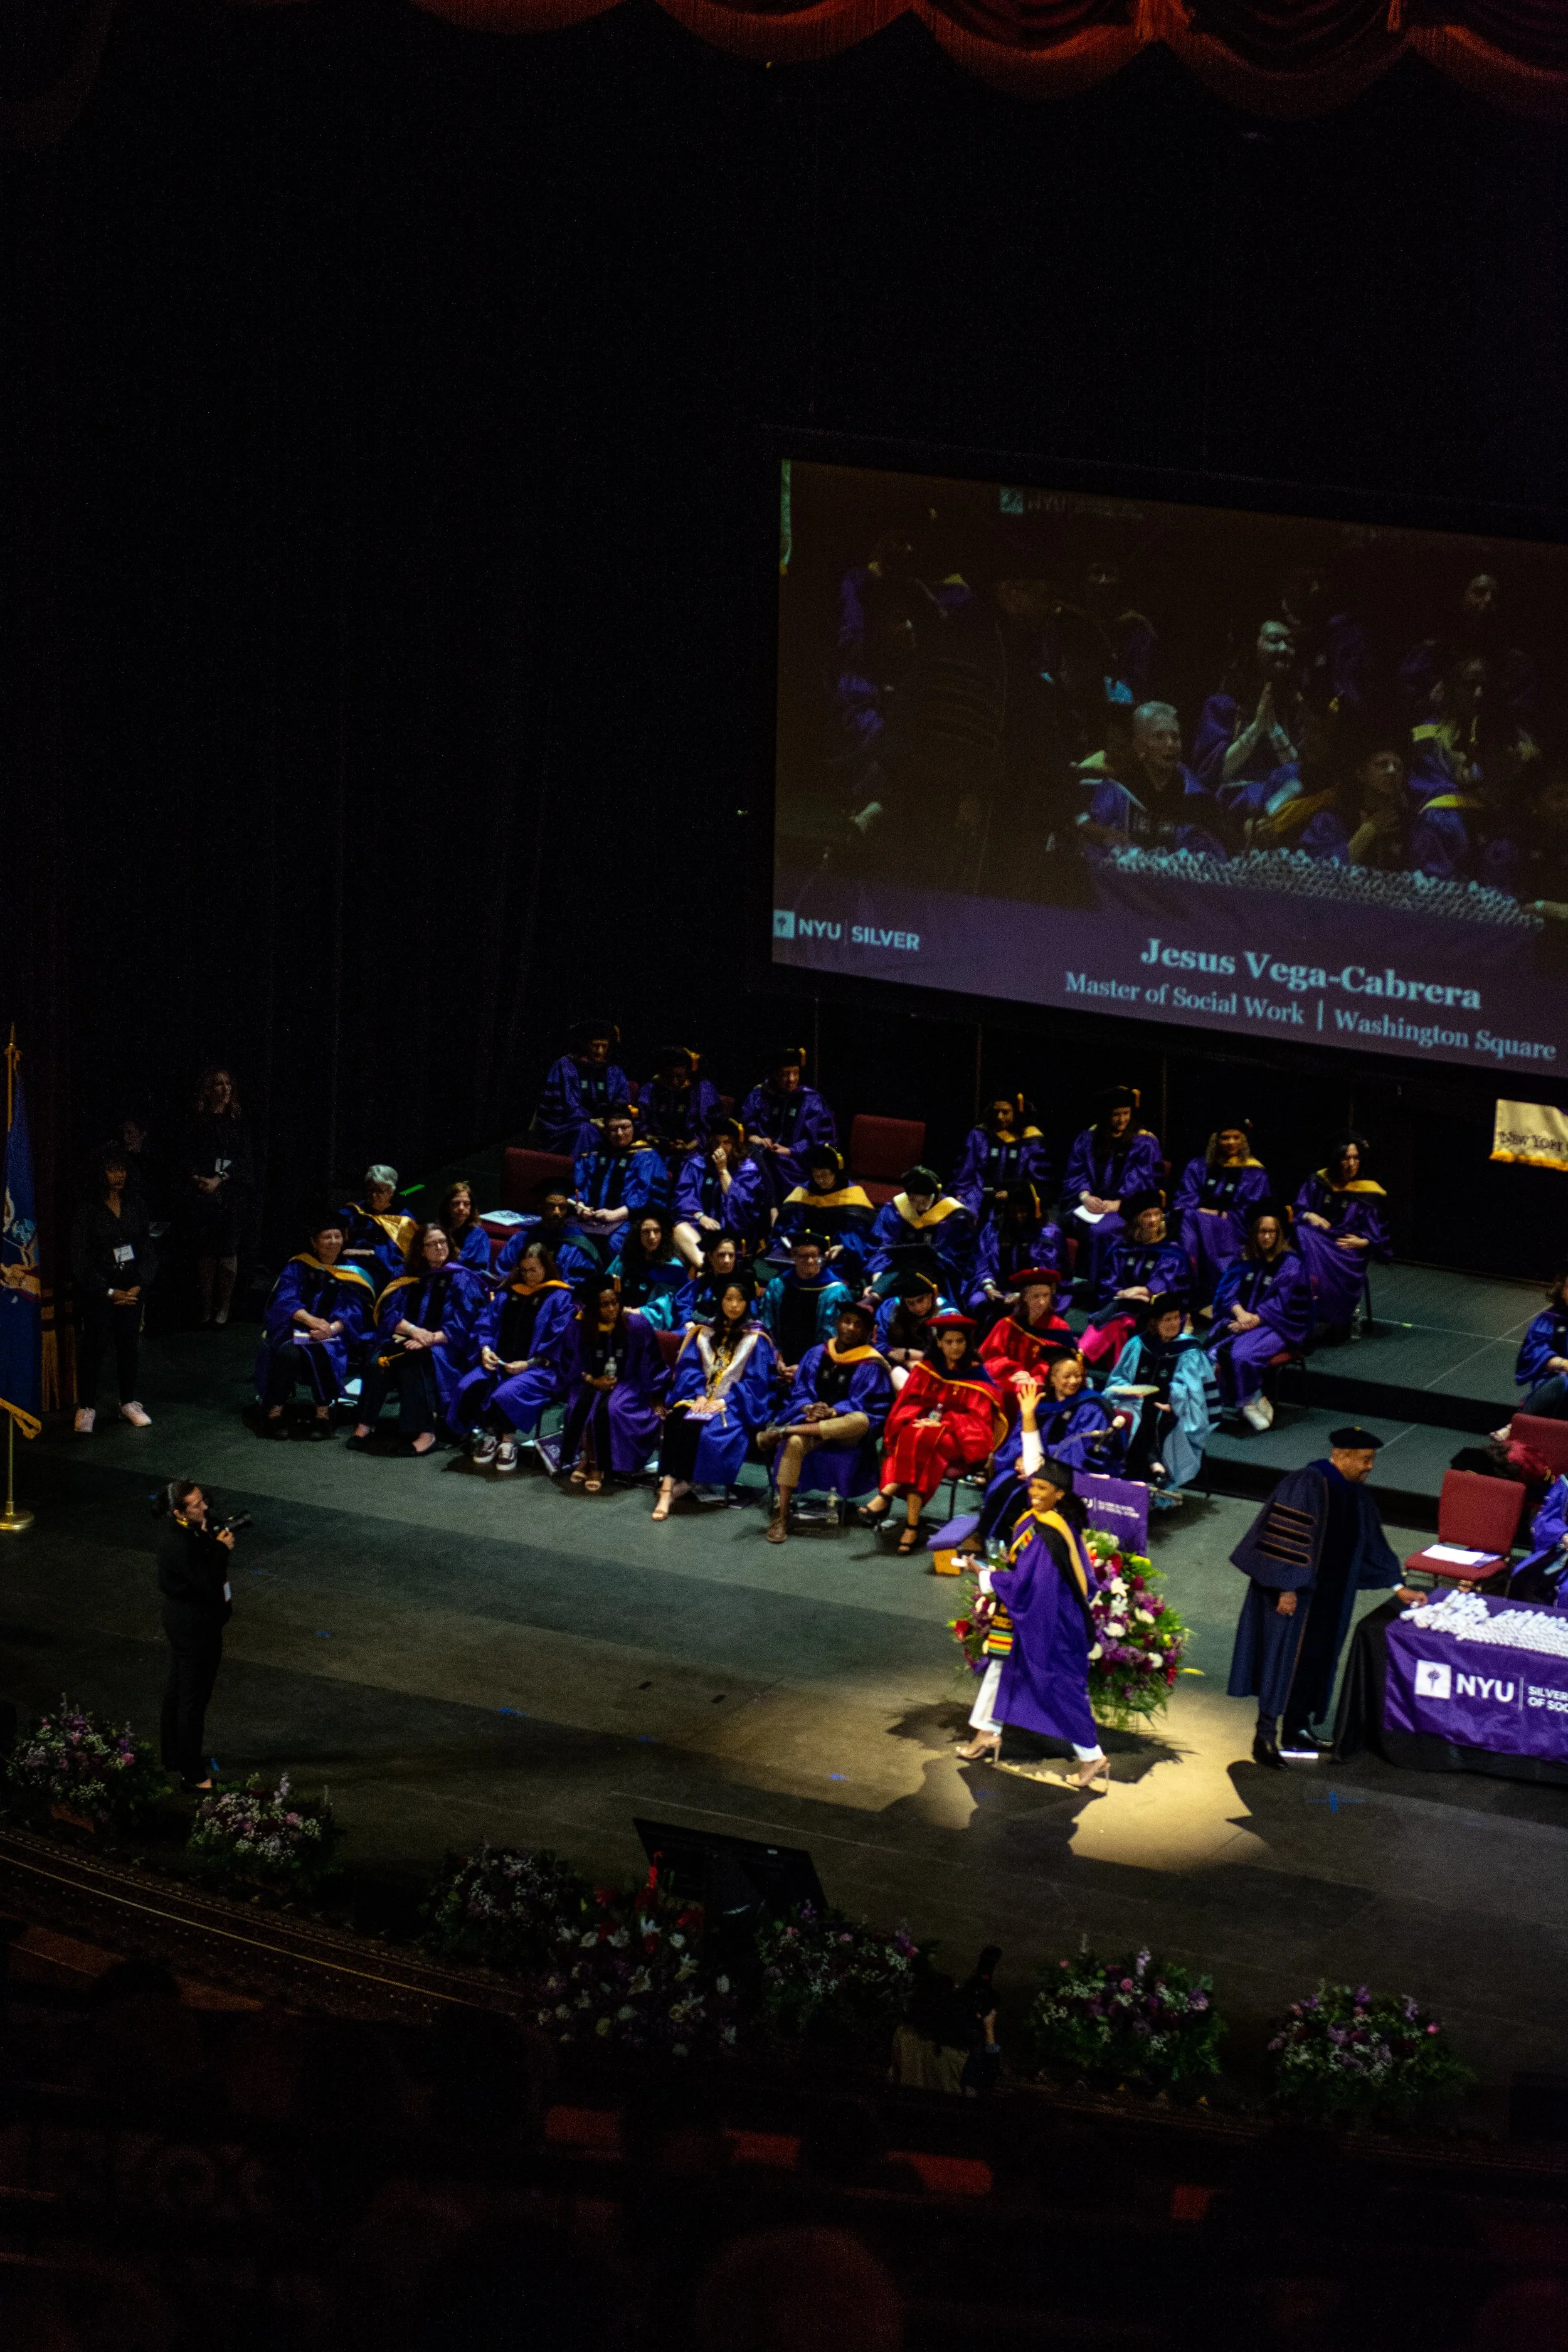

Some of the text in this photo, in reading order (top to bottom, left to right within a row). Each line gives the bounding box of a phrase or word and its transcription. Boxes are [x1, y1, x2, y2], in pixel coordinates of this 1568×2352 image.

[798, 918, 920, 951] NYU SILVER
[1140, 938, 1481, 1010] Jesus Vega-Cabrera
[1065, 971, 1141, 1001] Master
[1145, 983, 1170, 1005] of
[1172, 987, 1237, 1015] Social
[1243, 995, 1305, 1025] Work
[1334, 1009, 1469, 1048] Washington
[1476, 1030, 1557, 1060] Square
[1456, 1673, 1515, 1703] NYU
[1527, 1697, 1545, 1707] OF
[1528, 1685, 1568, 1701] SILVER
